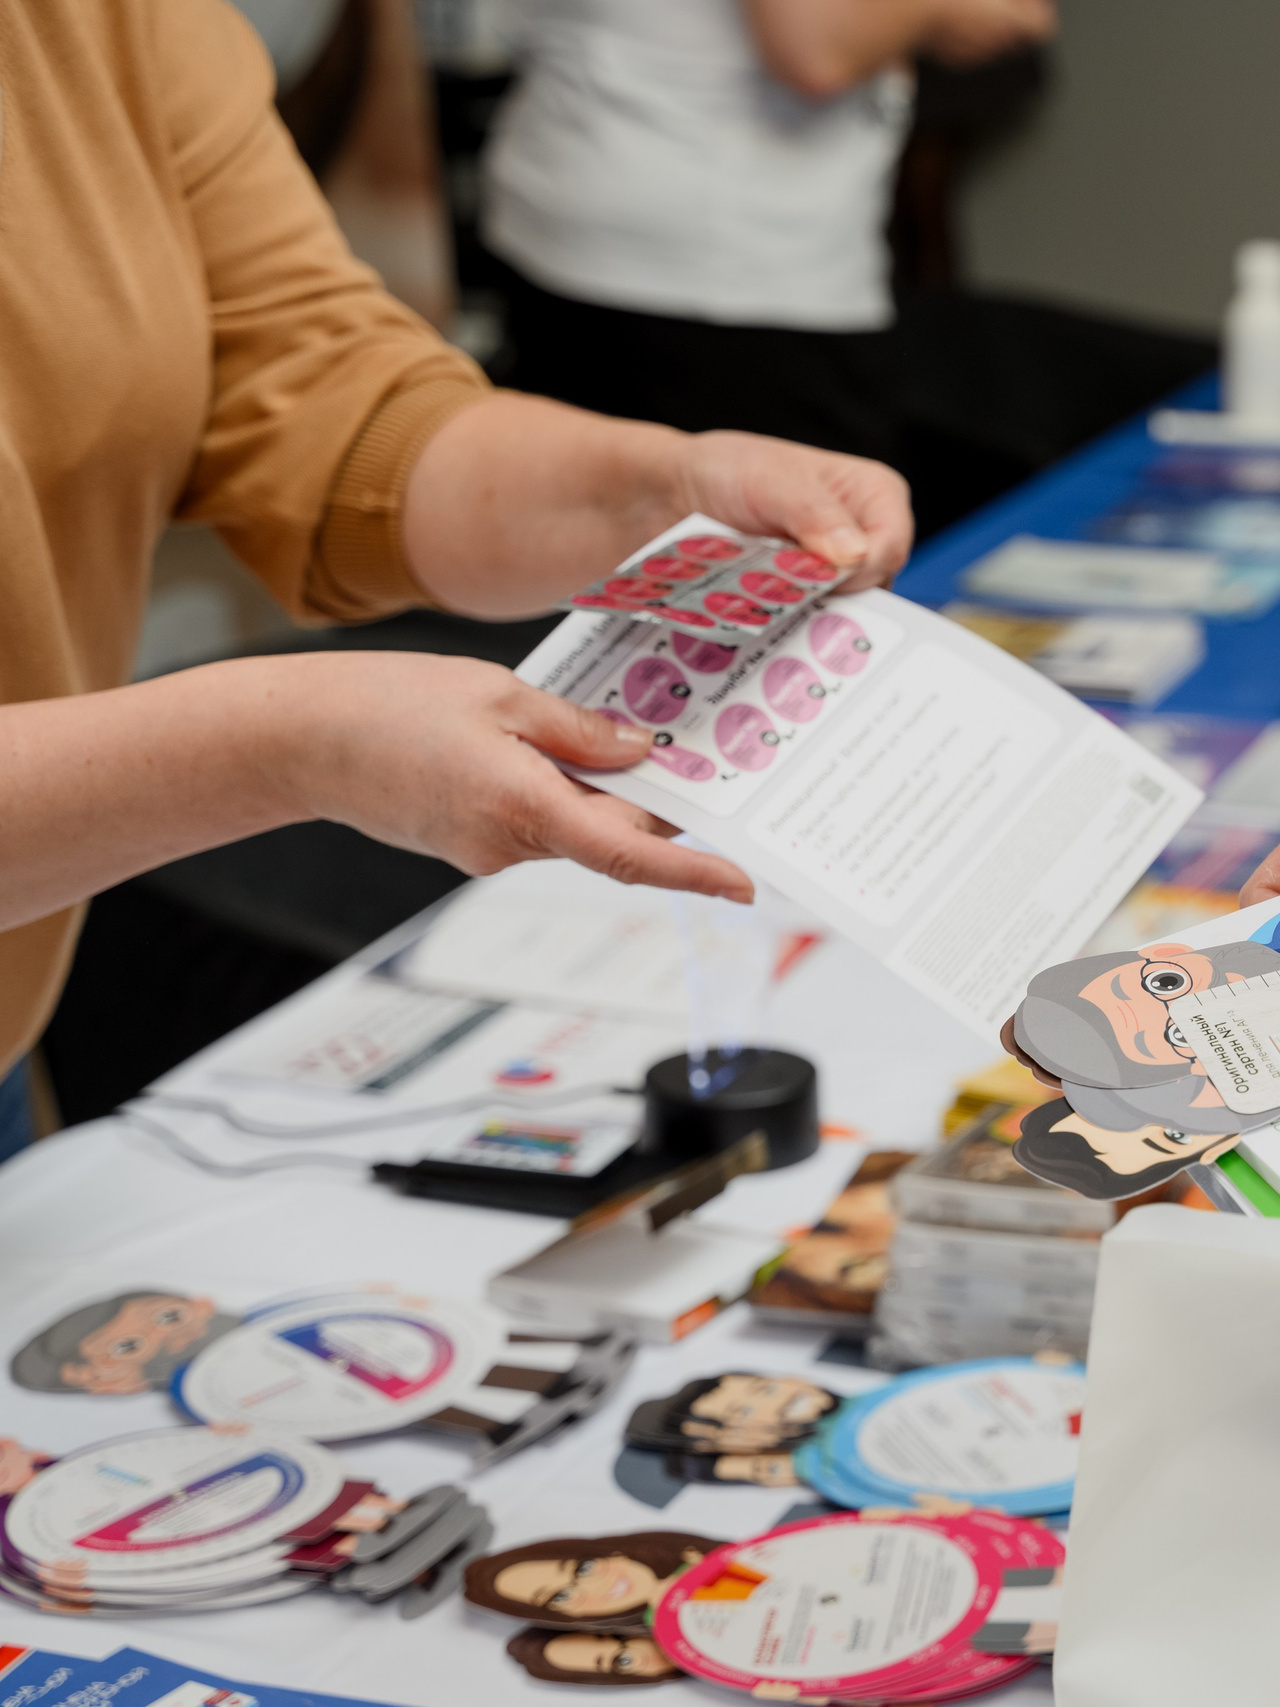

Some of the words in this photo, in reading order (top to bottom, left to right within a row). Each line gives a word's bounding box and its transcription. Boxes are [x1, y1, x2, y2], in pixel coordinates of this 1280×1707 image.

[1214, 1021, 1234, 1039] №1
[1242, 1026, 1270, 1062] лечения
[1190, 1014, 1249, 1093] Оригинальный
[1229, 1039, 1258, 1075] сартан
